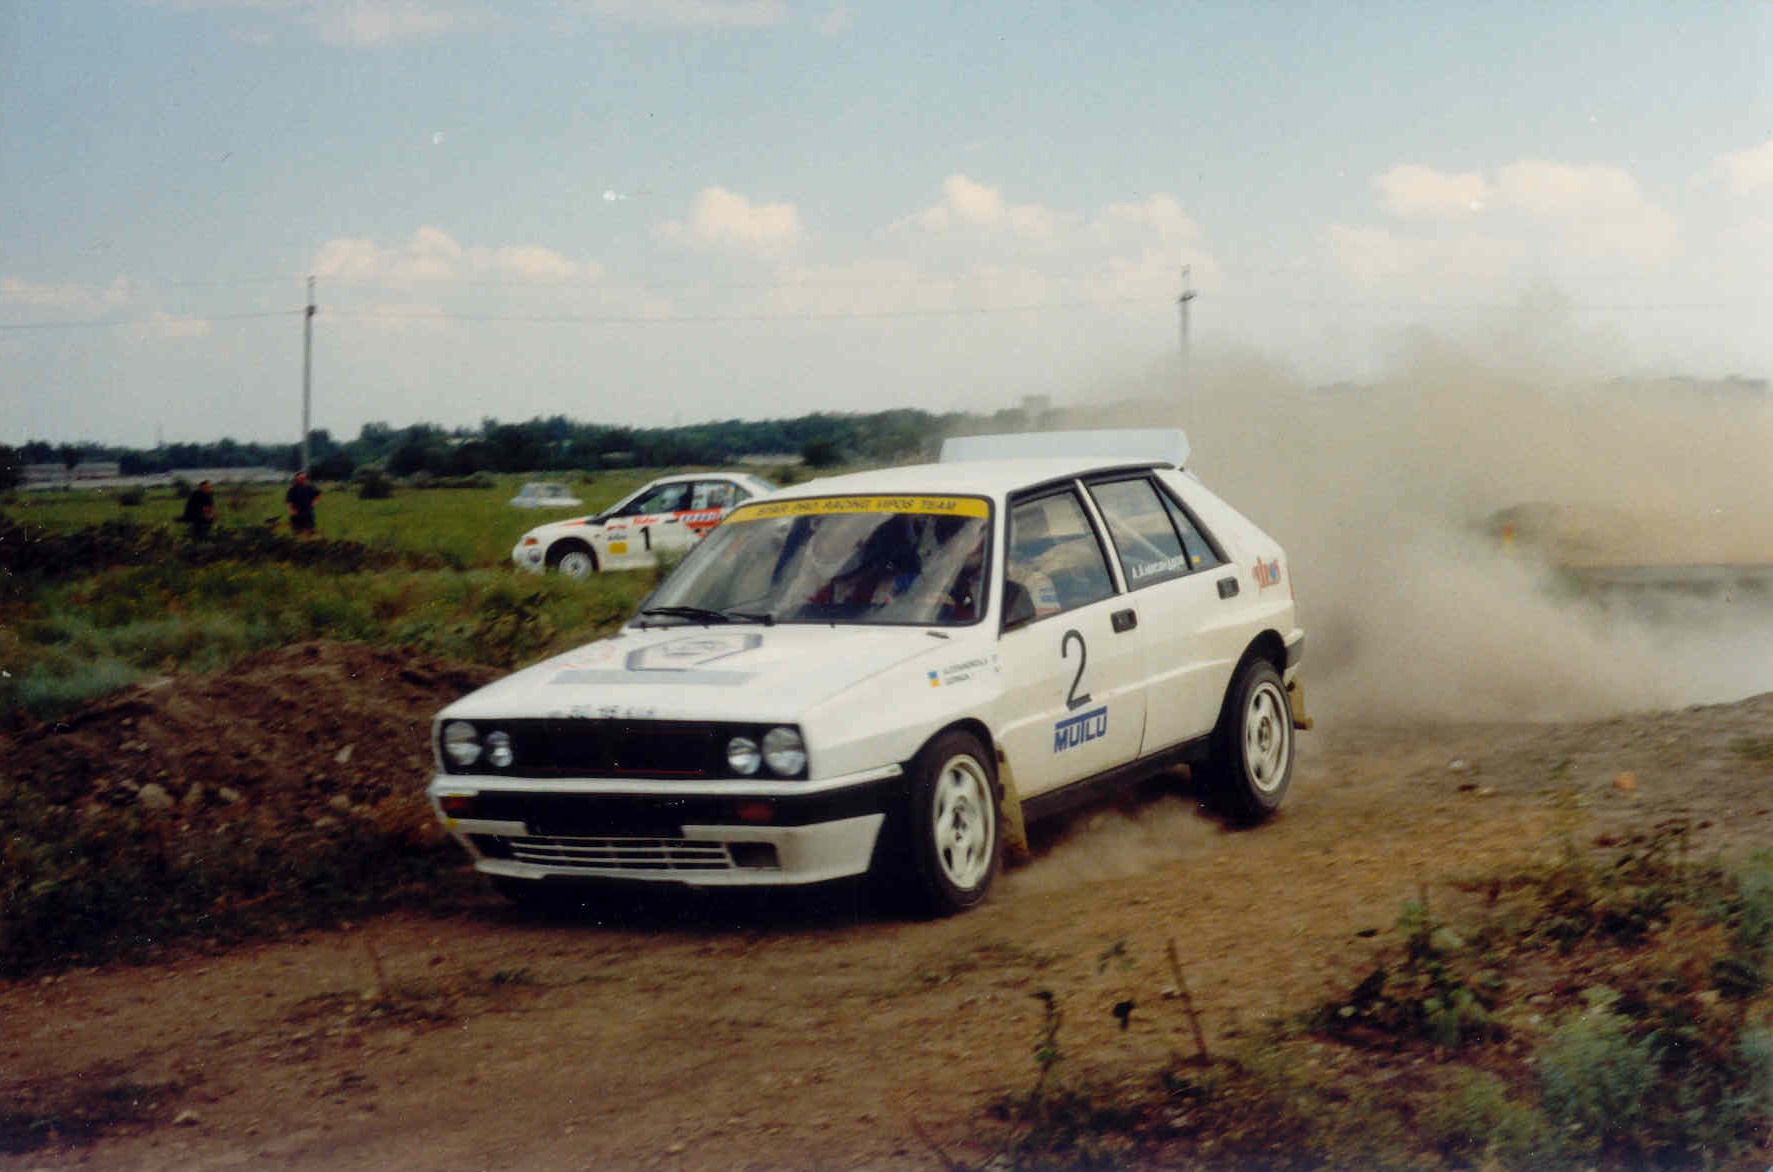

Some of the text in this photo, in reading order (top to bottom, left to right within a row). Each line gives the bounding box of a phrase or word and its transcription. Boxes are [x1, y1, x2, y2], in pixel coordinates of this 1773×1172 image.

[822, 499, 871, 513] RACING
[920, 499, 957, 511] TEAM
[640, 525, 651, 550] 1
[1061, 629, 1092, 711] 2
